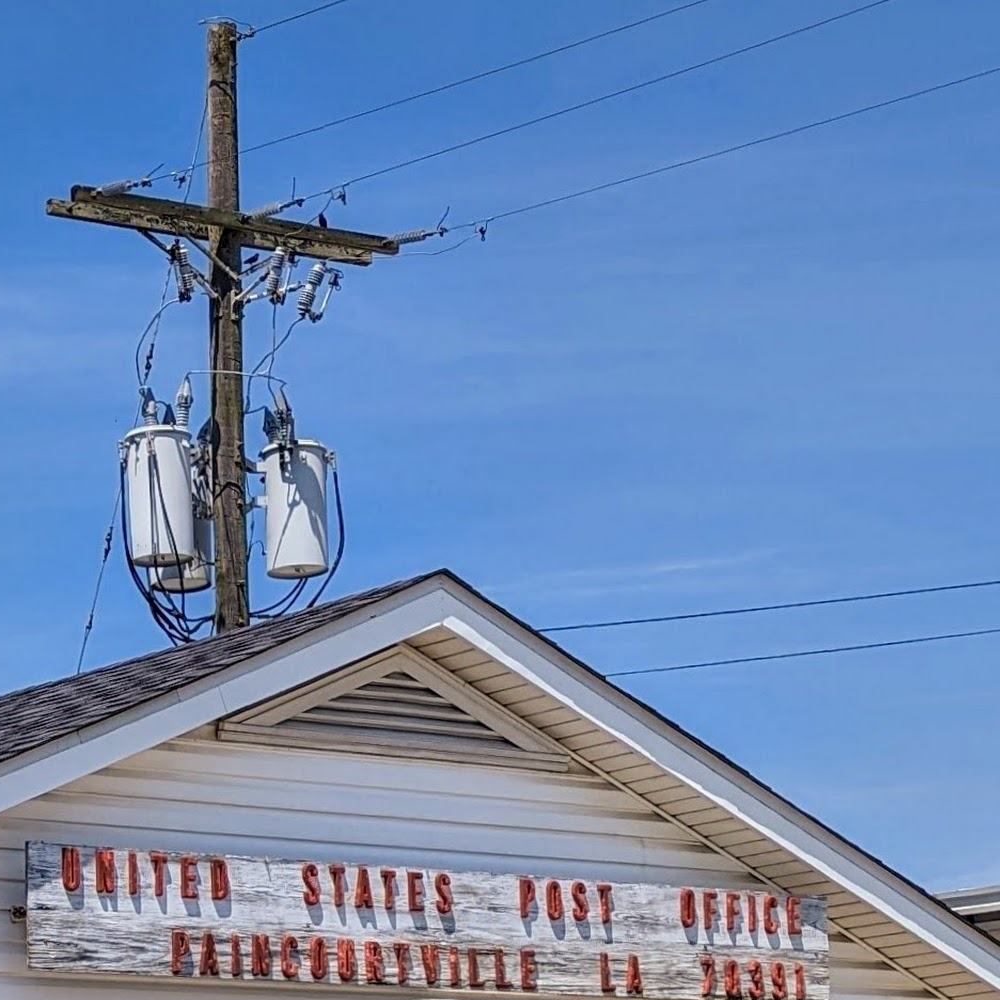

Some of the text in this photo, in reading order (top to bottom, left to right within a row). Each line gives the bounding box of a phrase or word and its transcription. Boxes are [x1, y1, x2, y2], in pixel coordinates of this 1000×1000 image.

[61, 847, 802, 935] UNITED STATES POST OFFICE
[171, 928, 537, 990] PAINCOURTVILLE
[599, 952, 643, 995] LA
